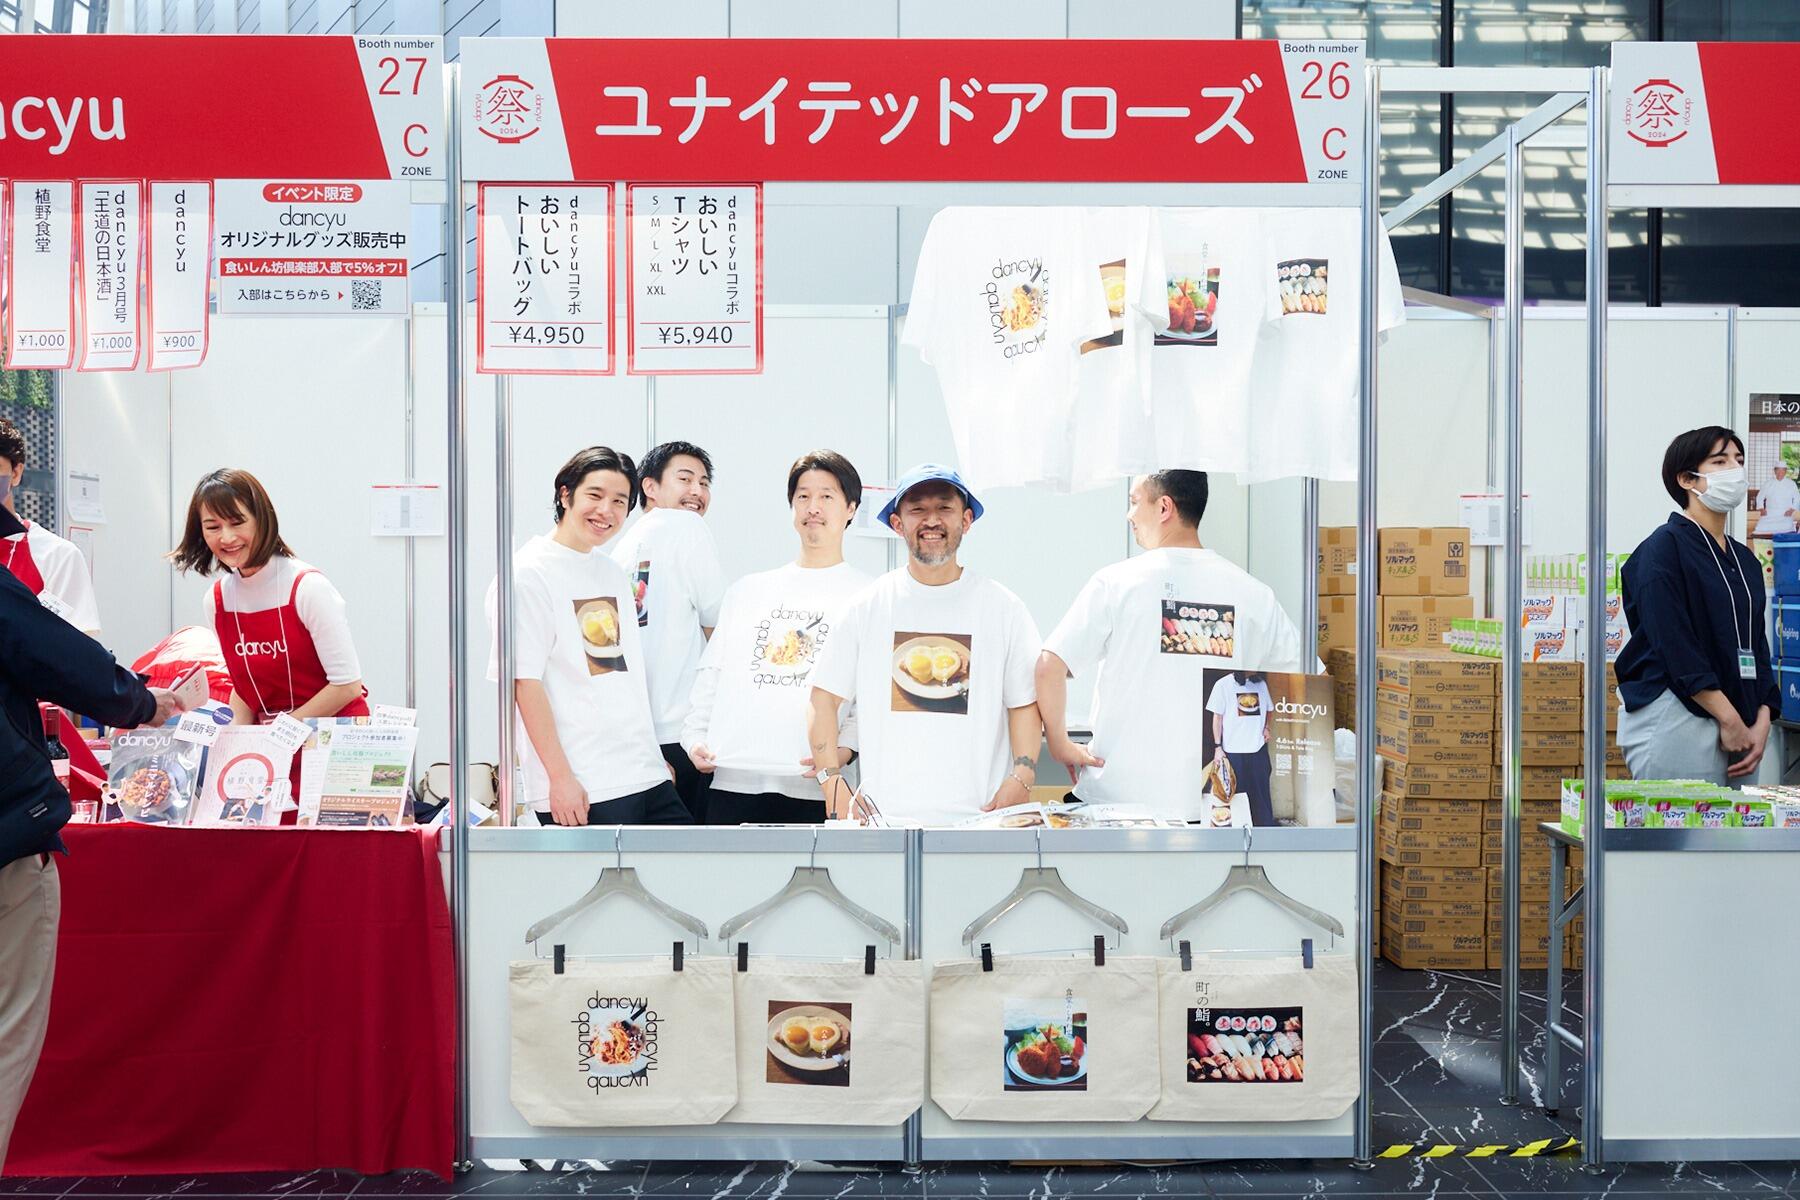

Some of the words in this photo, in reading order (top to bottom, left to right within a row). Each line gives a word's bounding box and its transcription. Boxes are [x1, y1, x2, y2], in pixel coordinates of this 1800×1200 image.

[359, 40, 391, 50] Booth
[394, 40, 435, 50] number
[1284, 43, 1316, 54] Booth
[1317, 44, 1359, 54] number
[378, 57, 428, 96] 27
[1300, 61, 1351, 100] 26
[486, 86, 531, 125] 祭
[595, 72, 1264, 148] ユナイテッドアローズ
[1635, 89, 1680, 129] 祭
[402, 124, 430, 158] C
[1321, 127, 1347, 161] C
[401, 167, 432, 176] ZONE
[1318, 169, 1349, 179] ZONE
[271, 186, 354, 201] イベント限定
[34, 188, 51, 254] 植野食堂
[279, 205, 347, 232] dancyu
[174, 190, 187, 273] dancyu
[220, 231, 407, 250] オリジナルグッズ販売中
[540, 195, 560, 276] おいしい
[671, 196, 690, 275] Tシャツ
[698, 195, 718, 276] おいしい
[93, 190, 111, 302] 「王道の日本酒」
[114, 191, 128, 324] dancyu3月号
[513, 195, 533, 317] トートバッグ
[568, 196, 581, 315] dancyuコラボ
[726, 196, 740, 315] dancyuコラボ
[237, 288, 331, 302] 入部はこちらから
[19, 334, 66, 348] ¥1,000
[92, 336, 133, 350] ¥1,000
[163, 335, 196, 349] ¥900
[509, 326, 585, 346] ¥4,950
[658, 326, 733, 346] ¥5,940
[1762, 400, 1800, 415] 日本の
[1386, 555, 1416, 564] ソルマック
[1523, 598, 1552, 607] ソルマック
[1388, 624, 1419, 632] ソルマック
[1534, 632, 1563, 640] ソルマック
[235, 632, 288, 660] dancyu
[1275, 696, 1327, 719] dancyu
[118, 731, 171, 753] dancyu
[587, 990, 648, 1014] dancyu
[645, 1011, 665, 1070] dancyu
